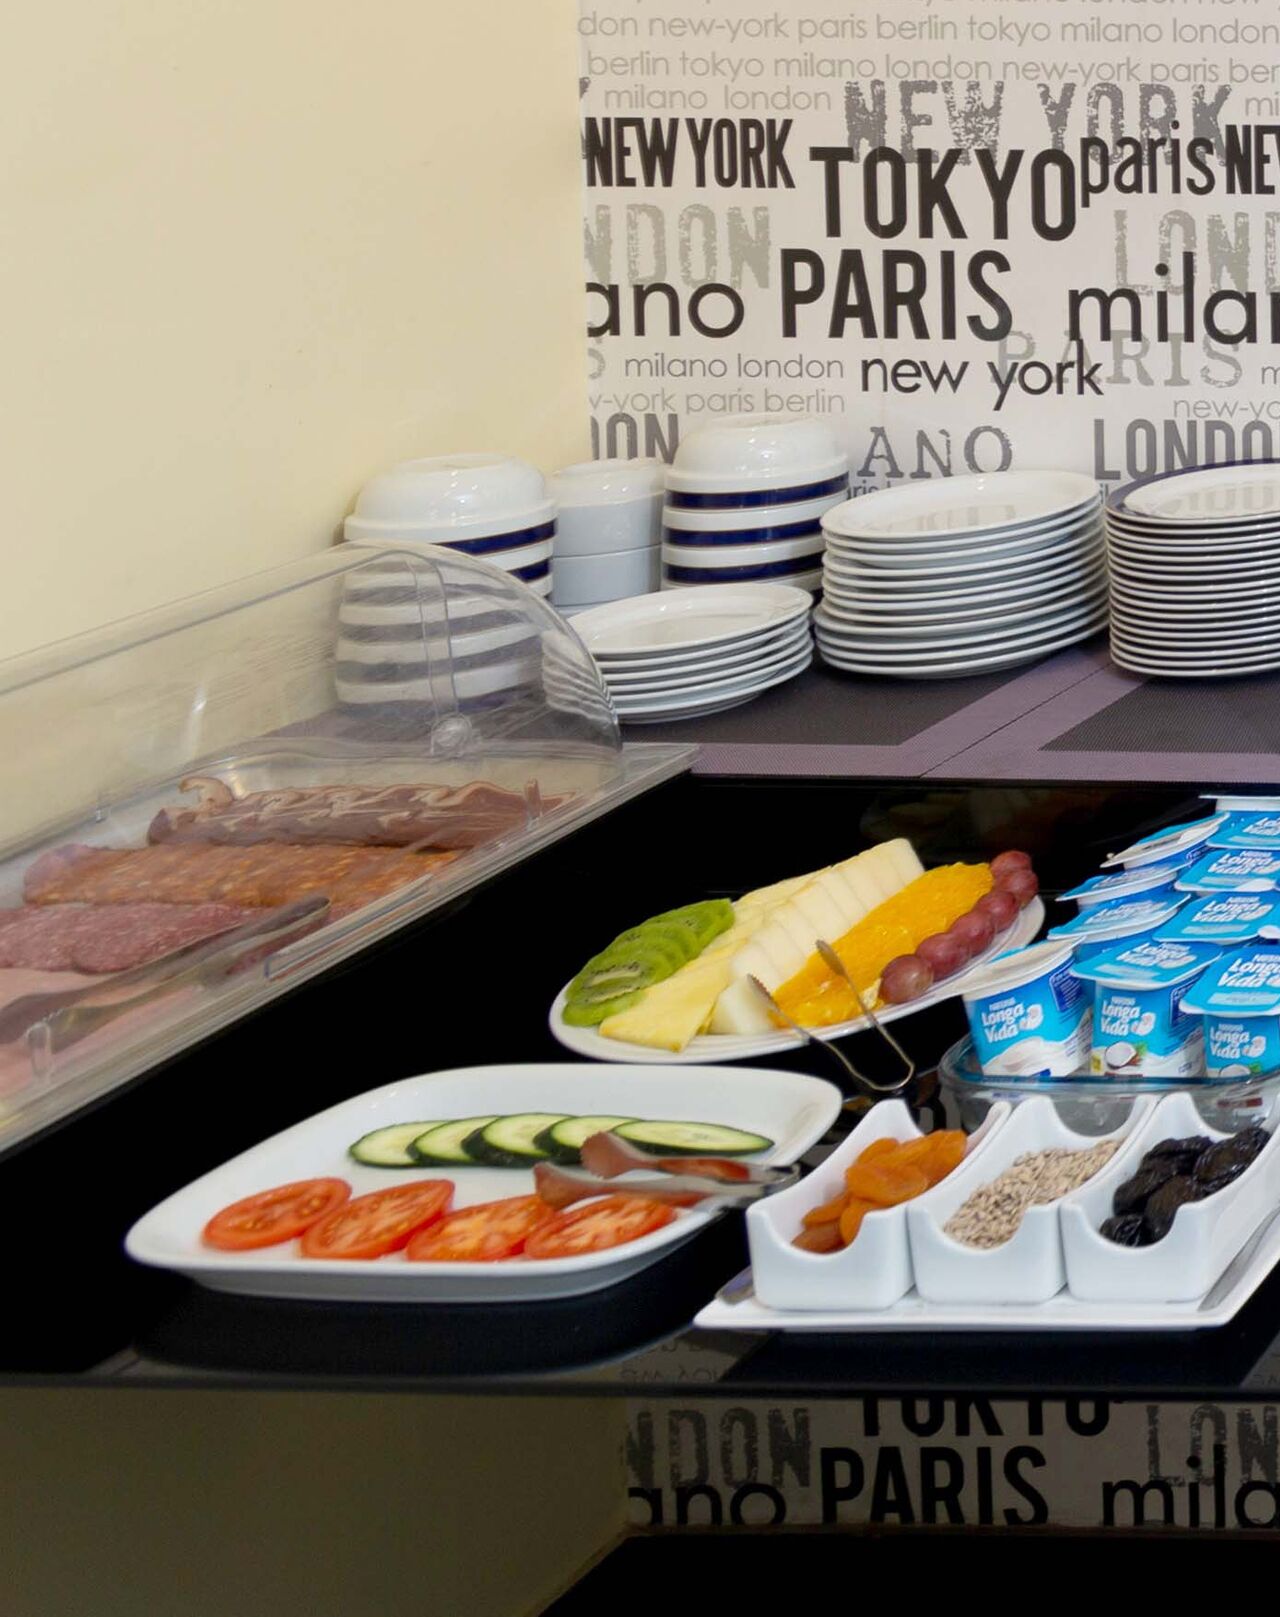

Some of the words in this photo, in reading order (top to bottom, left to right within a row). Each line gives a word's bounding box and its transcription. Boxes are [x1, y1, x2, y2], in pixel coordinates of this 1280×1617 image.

[586, 117, 680, 188] NEW
[687, 118, 795, 189] YORK
[1080, 120, 1215, 208] paris
[810, 146, 1076, 241] TOKYO
[780, 248, 1013, 342] PARIS
[624, 352, 728, 378] milano
[738, 354, 844, 379] london
[862, 358, 969, 394] new
[988, 340, 1103, 411] york
[1217, 973, 1266, 988] Vida
[981, 1002, 1025, 1028] Longa
[984, 1023, 1018, 1043] Vida
[1100, 1017, 1129, 1036] Vida
[1101, 1002, 1142, 1023] Longa
[821, 1445, 1049, 1526] PARIS
